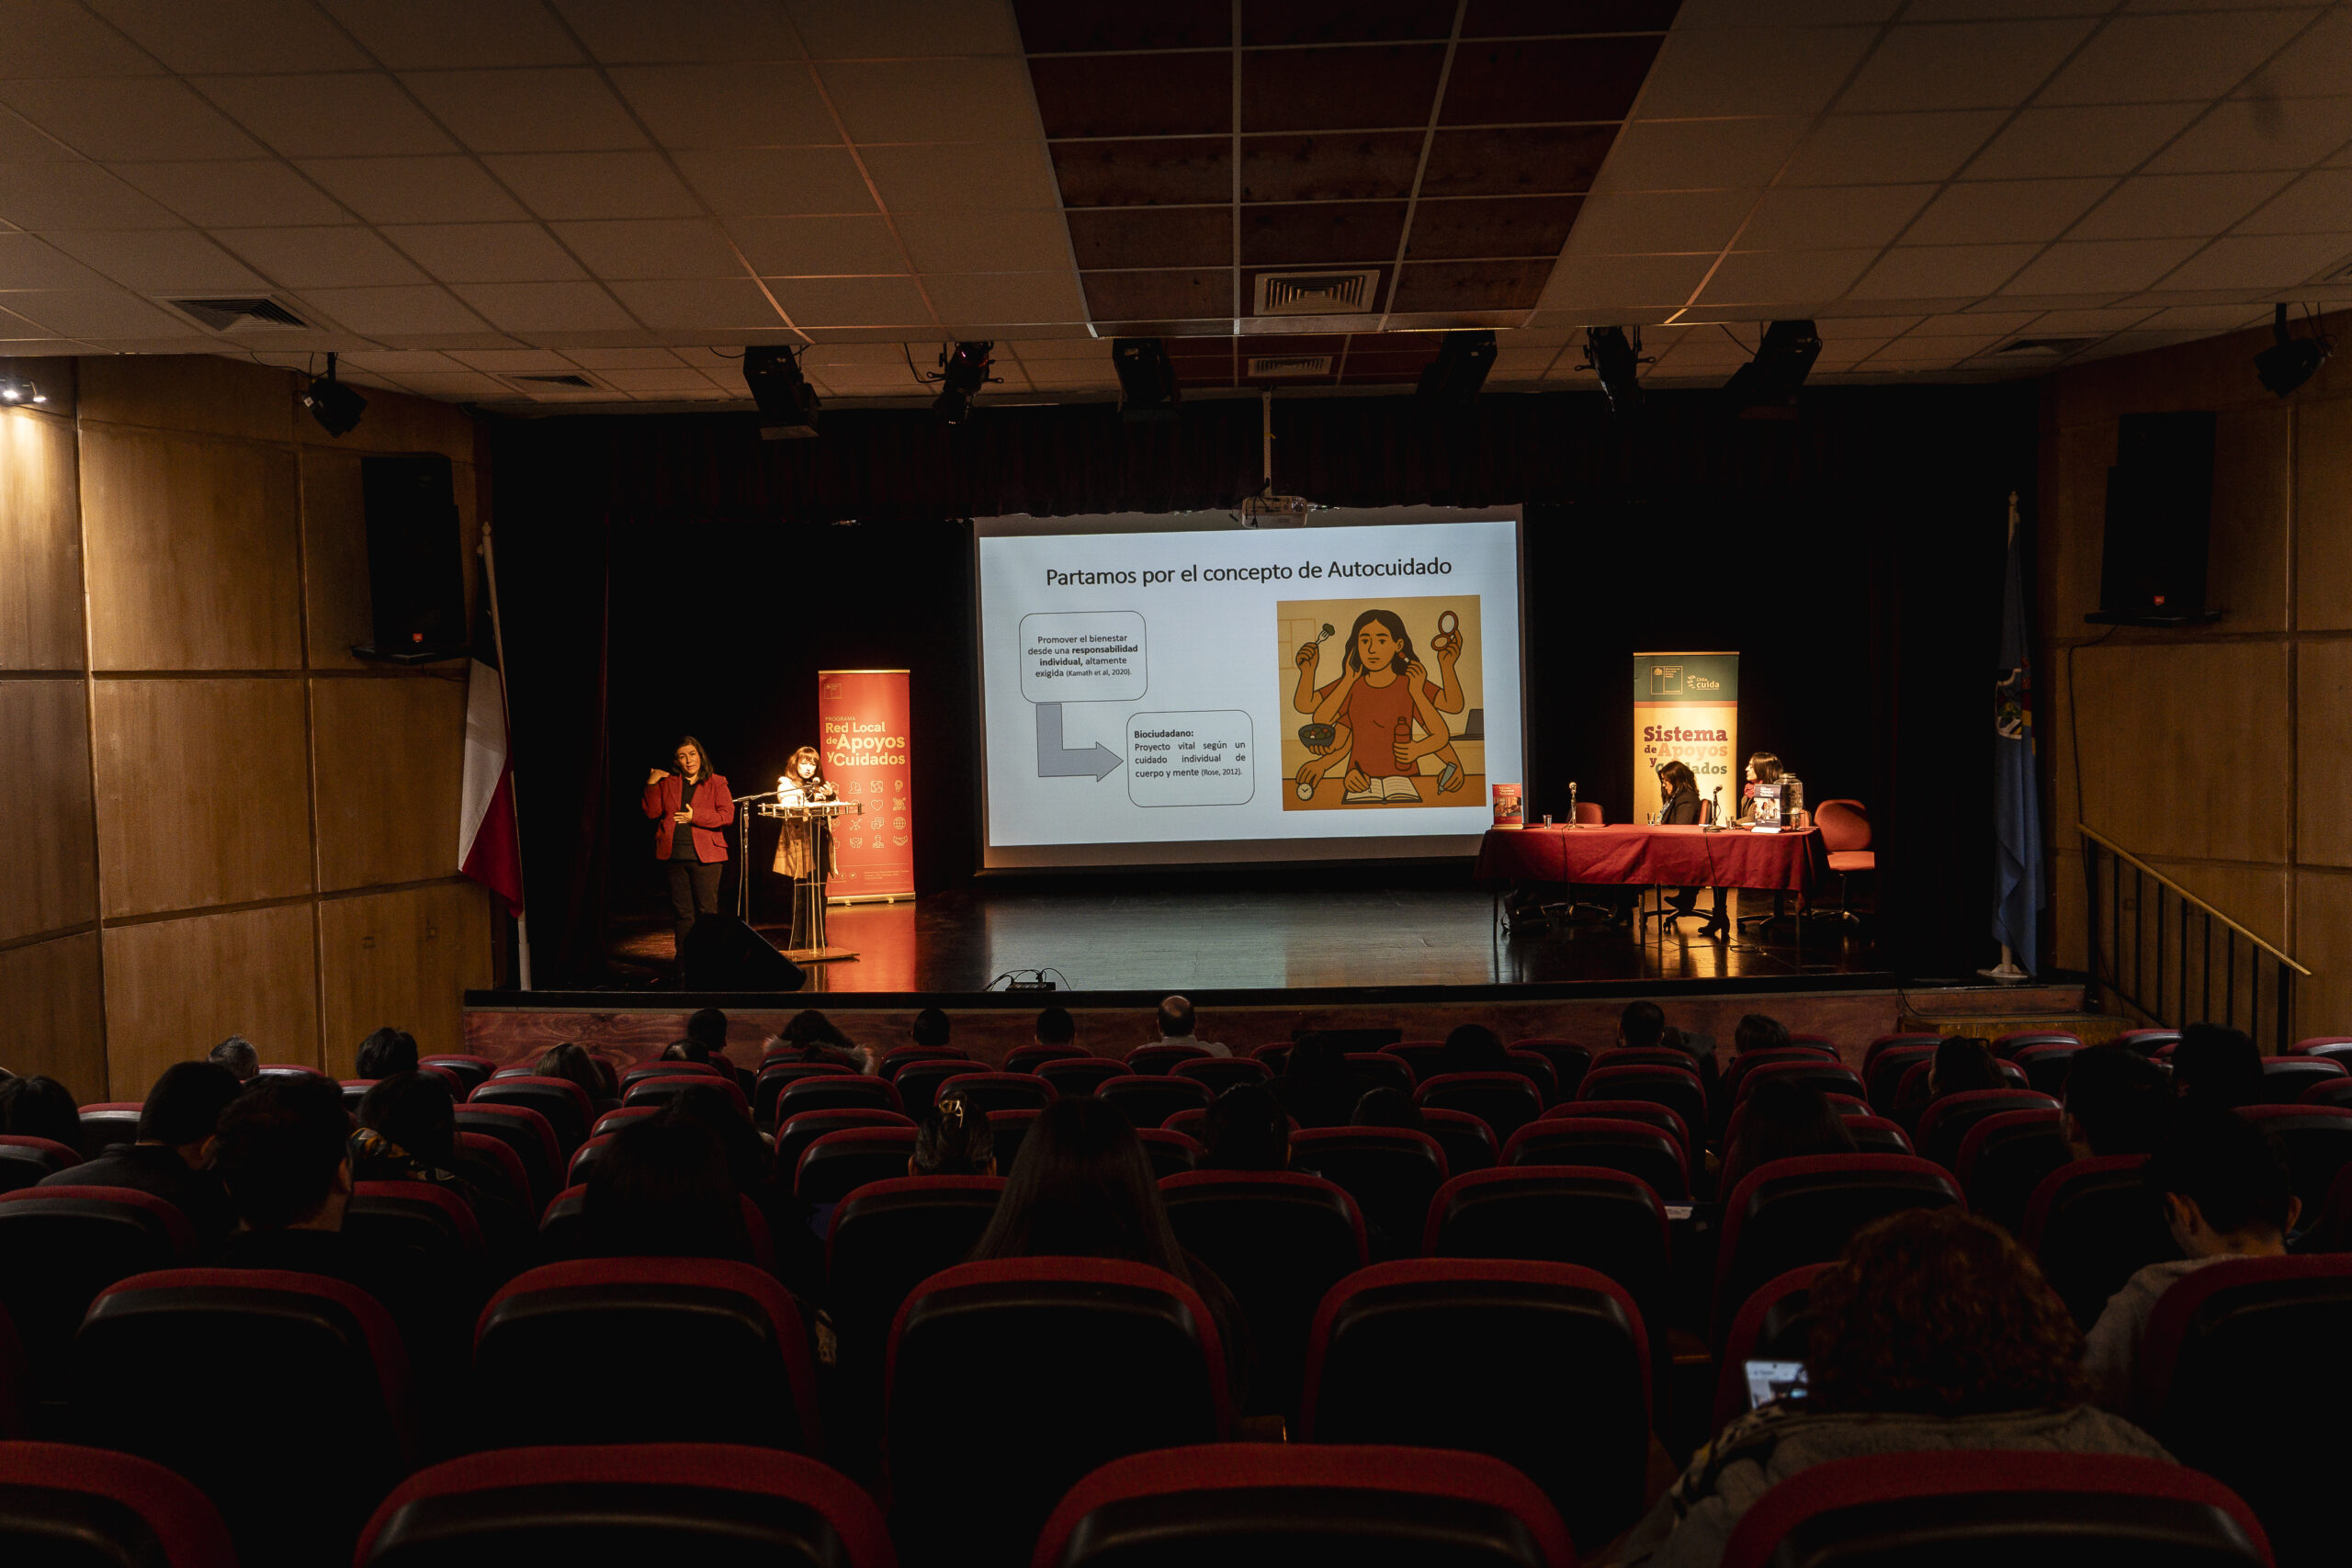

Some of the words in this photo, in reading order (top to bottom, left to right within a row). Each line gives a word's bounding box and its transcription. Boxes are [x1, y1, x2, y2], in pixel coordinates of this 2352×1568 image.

[1046, 569, 1136, 586] Partamos
[1143, 570, 1176, 587] por
[1181, 564, 1197, 581] el
[1204, 563, 1293, 583] concepto
[1298, 560, 1323, 579] de
[1328, 557, 1453, 578] Autocuidado
[1037, 636, 1078, 644] Promover
[1080, 635, 1088, 643] el
[1089, 635, 1127, 643] bienestar
[1071, 645, 1138, 655] responsabilidad
[1039, 658, 1083, 667] individual,
[1085, 656, 1127, 665] altamente
[1035, 669, 1064, 679] exigida
[1066, 670, 1093, 678] (Kamath
[1102, 669, 1111, 677] al,
[1112, 668, 1133, 676] 2020).
[1696, 681, 1720, 689] cuida
[825, 722, 849, 734] Red
[853, 721, 887, 733] Local
[1134, 729, 1194, 739] Biociudadano:
[1644, 725, 1728, 742] Sistema
[826, 737, 837, 745] de
[836, 734, 906, 753] Apoyos
[1135, 742, 1171, 752] Proyecto
[1178, 741, 1195, 750] vital
[1203, 740, 1227, 751] según
[1644, 745, 1657, 754] de
[1657, 742, 1728, 761] Apoyos
[827, 751, 835, 763] y
[833, 752, 906, 767] Cuidados
[1135, 755, 1168, 764] cuidado
[1182, 753, 1221, 763] individual
[1235, 753, 1246, 761] de
[1649, 757, 1657, 768] y
[1655, 762, 1728, 774] Cados
[1135, 770, 1164, 779] cuerpo
[1166, 770, 1171, 778] y
[1172, 768, 1200, 777] mente
[1201, 768, 1221, 777] (Rose,
[1222, 768, 1243, 776] 2012).
